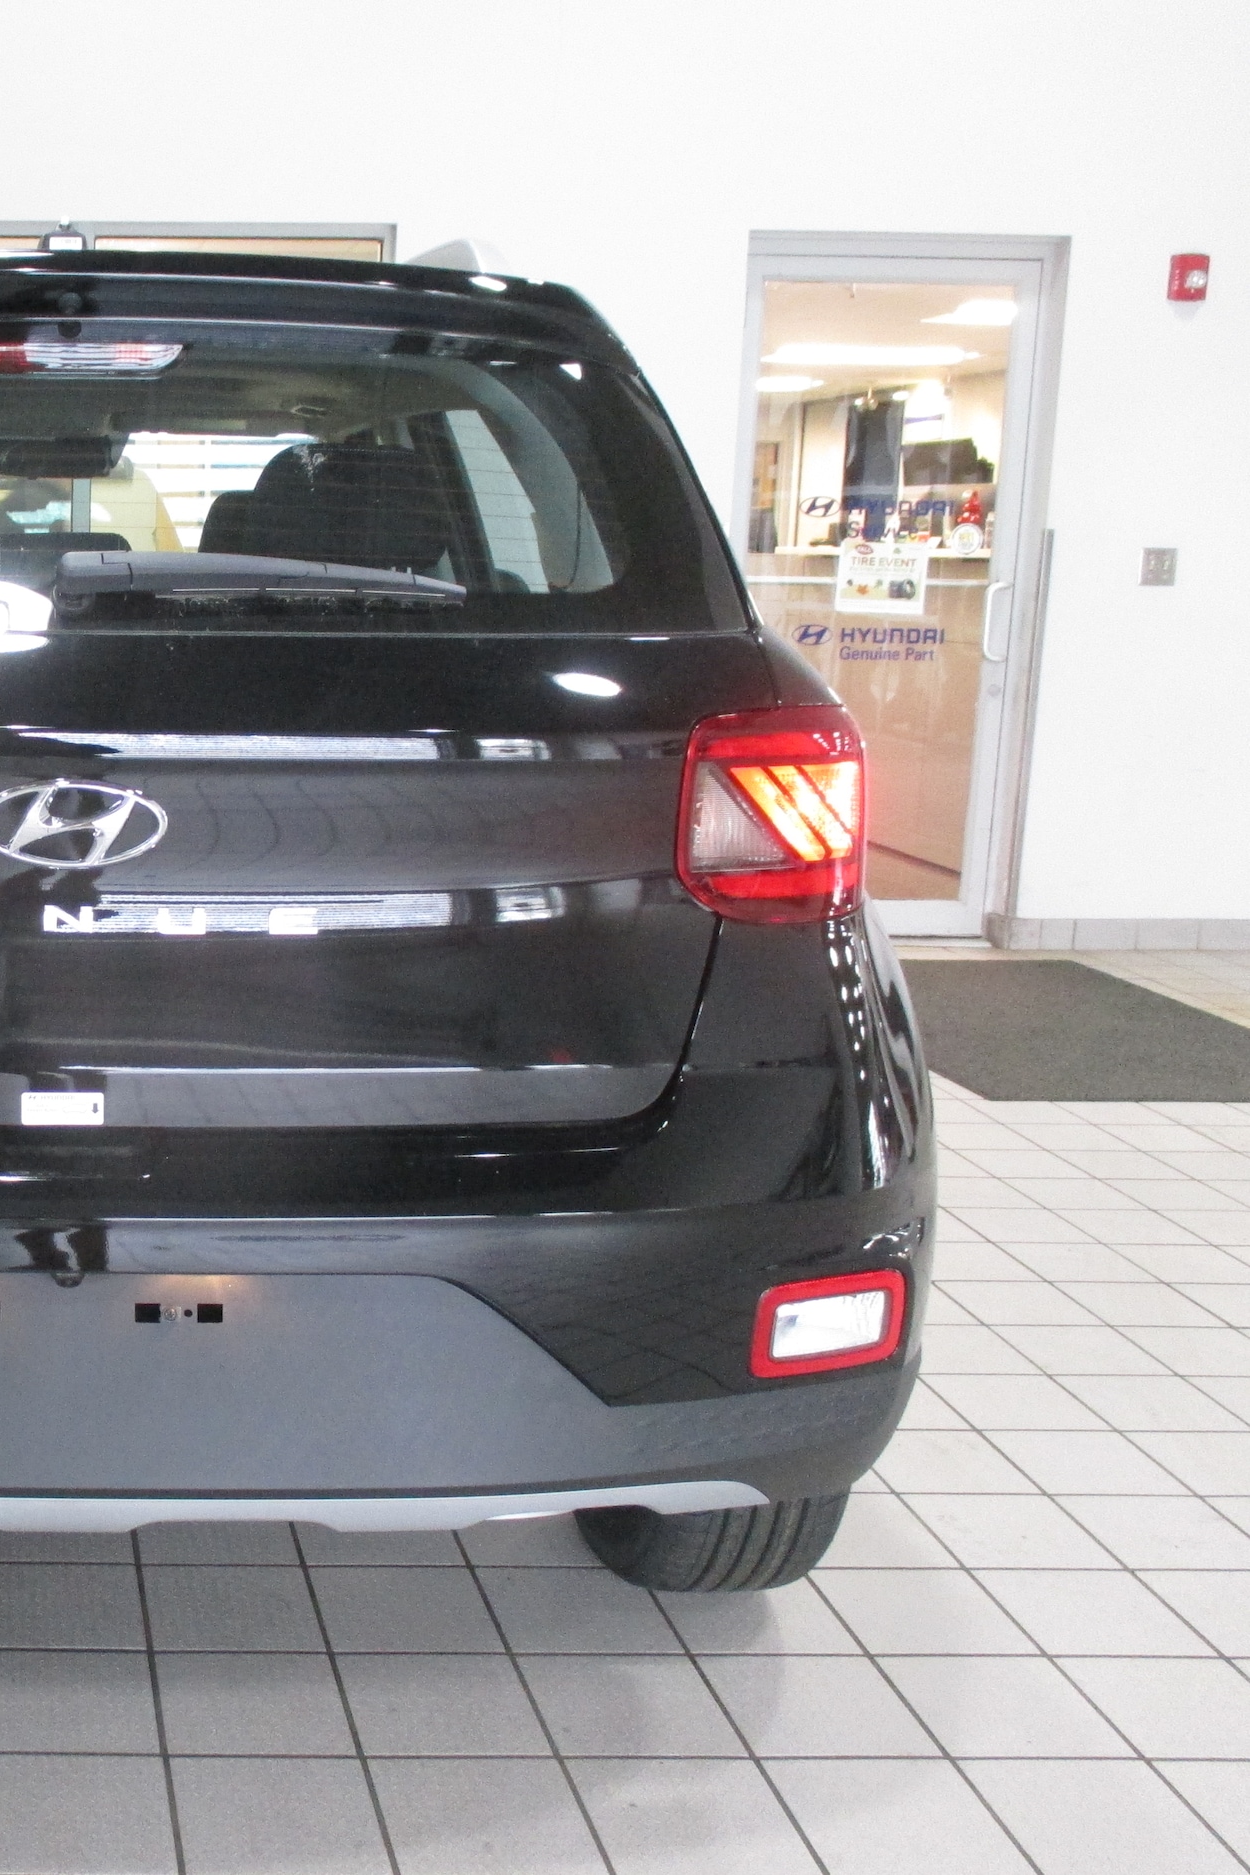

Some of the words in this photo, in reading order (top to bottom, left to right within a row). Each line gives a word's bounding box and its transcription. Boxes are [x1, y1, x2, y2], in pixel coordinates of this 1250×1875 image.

[851, 557, 876, 566] TIRE
[878, 557, 917, 567] EVENT
[840, 627, 945, 644] HYUNDAI
[839, 645, 900, 661] Genuine
[904, 646, 935, 661] Part
